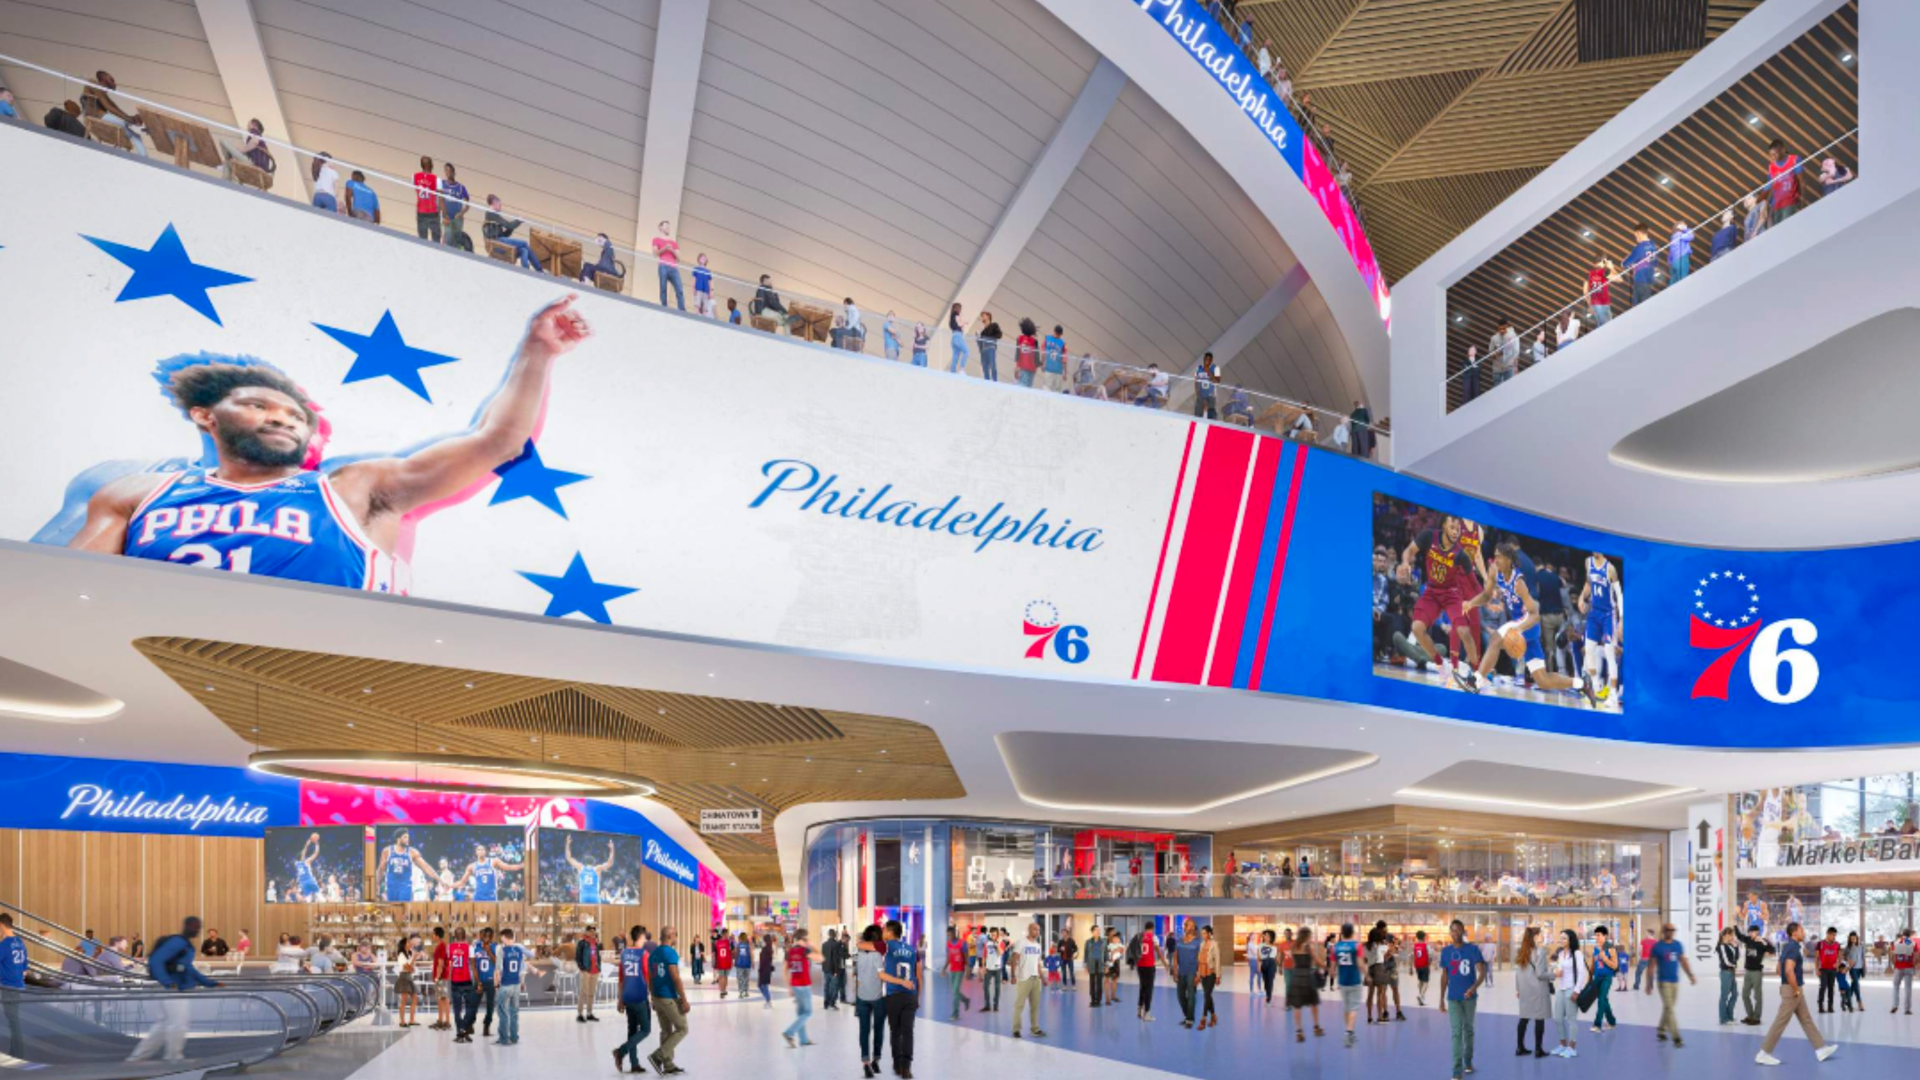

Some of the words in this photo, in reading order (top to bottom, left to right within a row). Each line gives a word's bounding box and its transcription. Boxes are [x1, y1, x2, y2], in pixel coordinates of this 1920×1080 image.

[137, 500, 313, 546] PHILA
[747, 459, 1104, 553] Philadelphia
[1023, 620, 1090, 664] 76
[1690, 613, 1819, 704] 76
[60, 784, 269, 830] Philadelphia
[1787, 840, 1866, 867] Market
[1696, 853, 1712, 916] STREET
[12, 950, 25, 964] 21
[1696, 923, 1712, 961] 10TH
[452, 955, 463, 968] 21
[509, 960, 518, 973] 0
[624, 960, 639, 976] 21
[1450, 959, 1470, 976] 76
